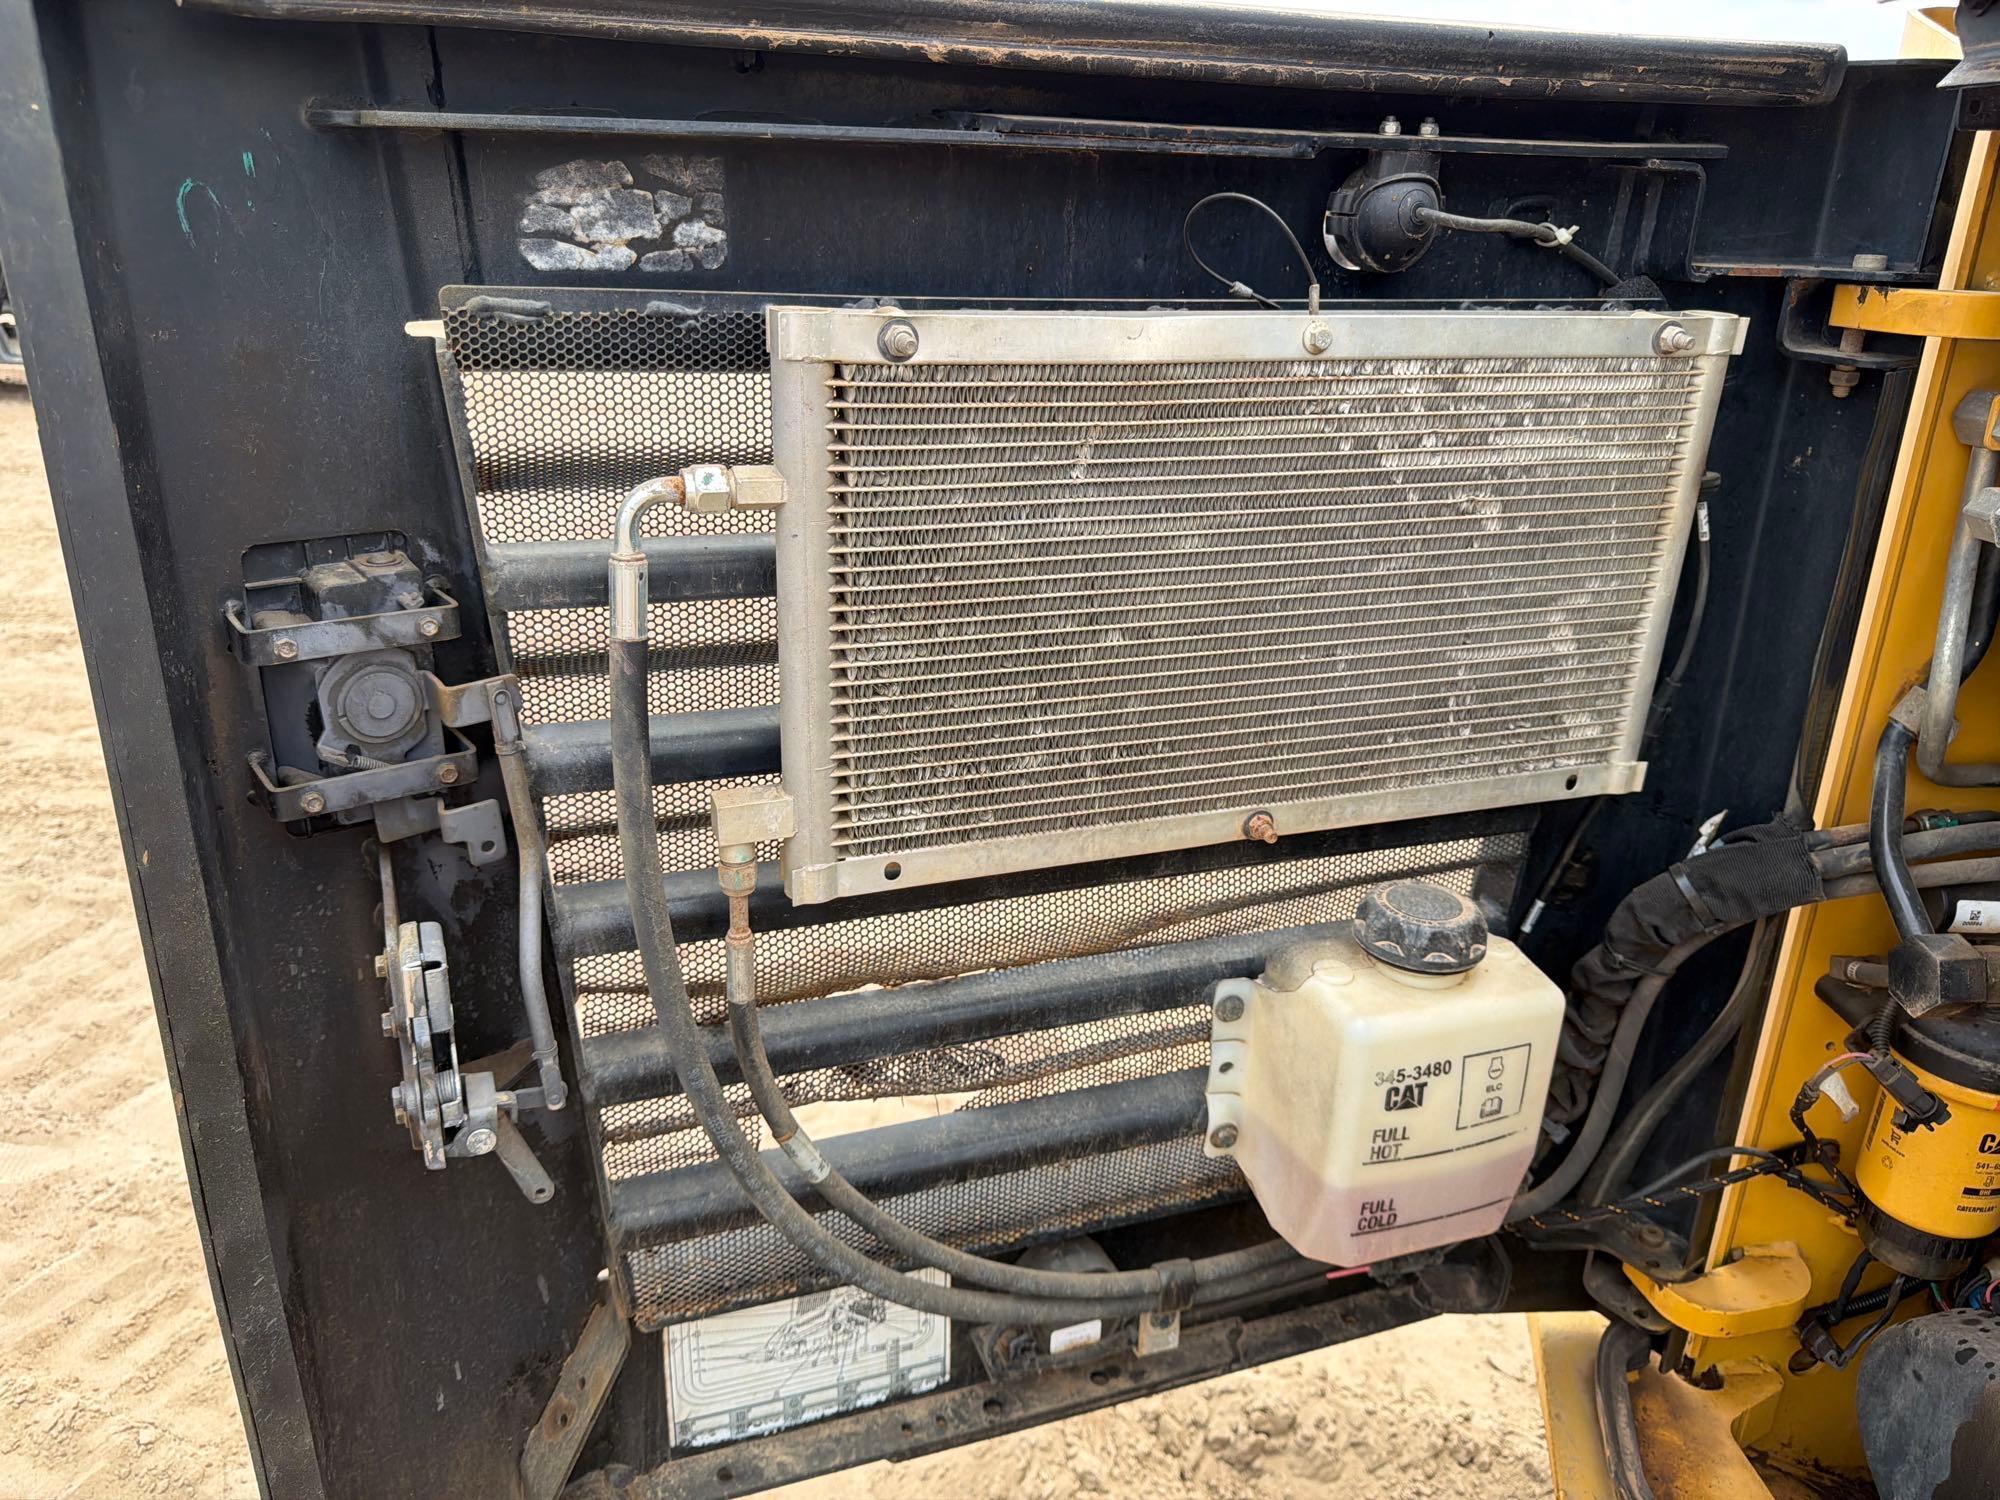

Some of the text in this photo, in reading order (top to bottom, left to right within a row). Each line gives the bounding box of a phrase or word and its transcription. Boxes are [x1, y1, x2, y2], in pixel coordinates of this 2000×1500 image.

[1374, 1060, 1452, 1087] 345-3480
[1384, 1082, 1428, 1111] CAT
[1372, 1127, 1410, 1144] FULL
[1370, 1144, 1402, 1160] HOT
[1360, 1199, 1396, 1215] FULL
[1357, 1214, 1397, 1231] COLD
